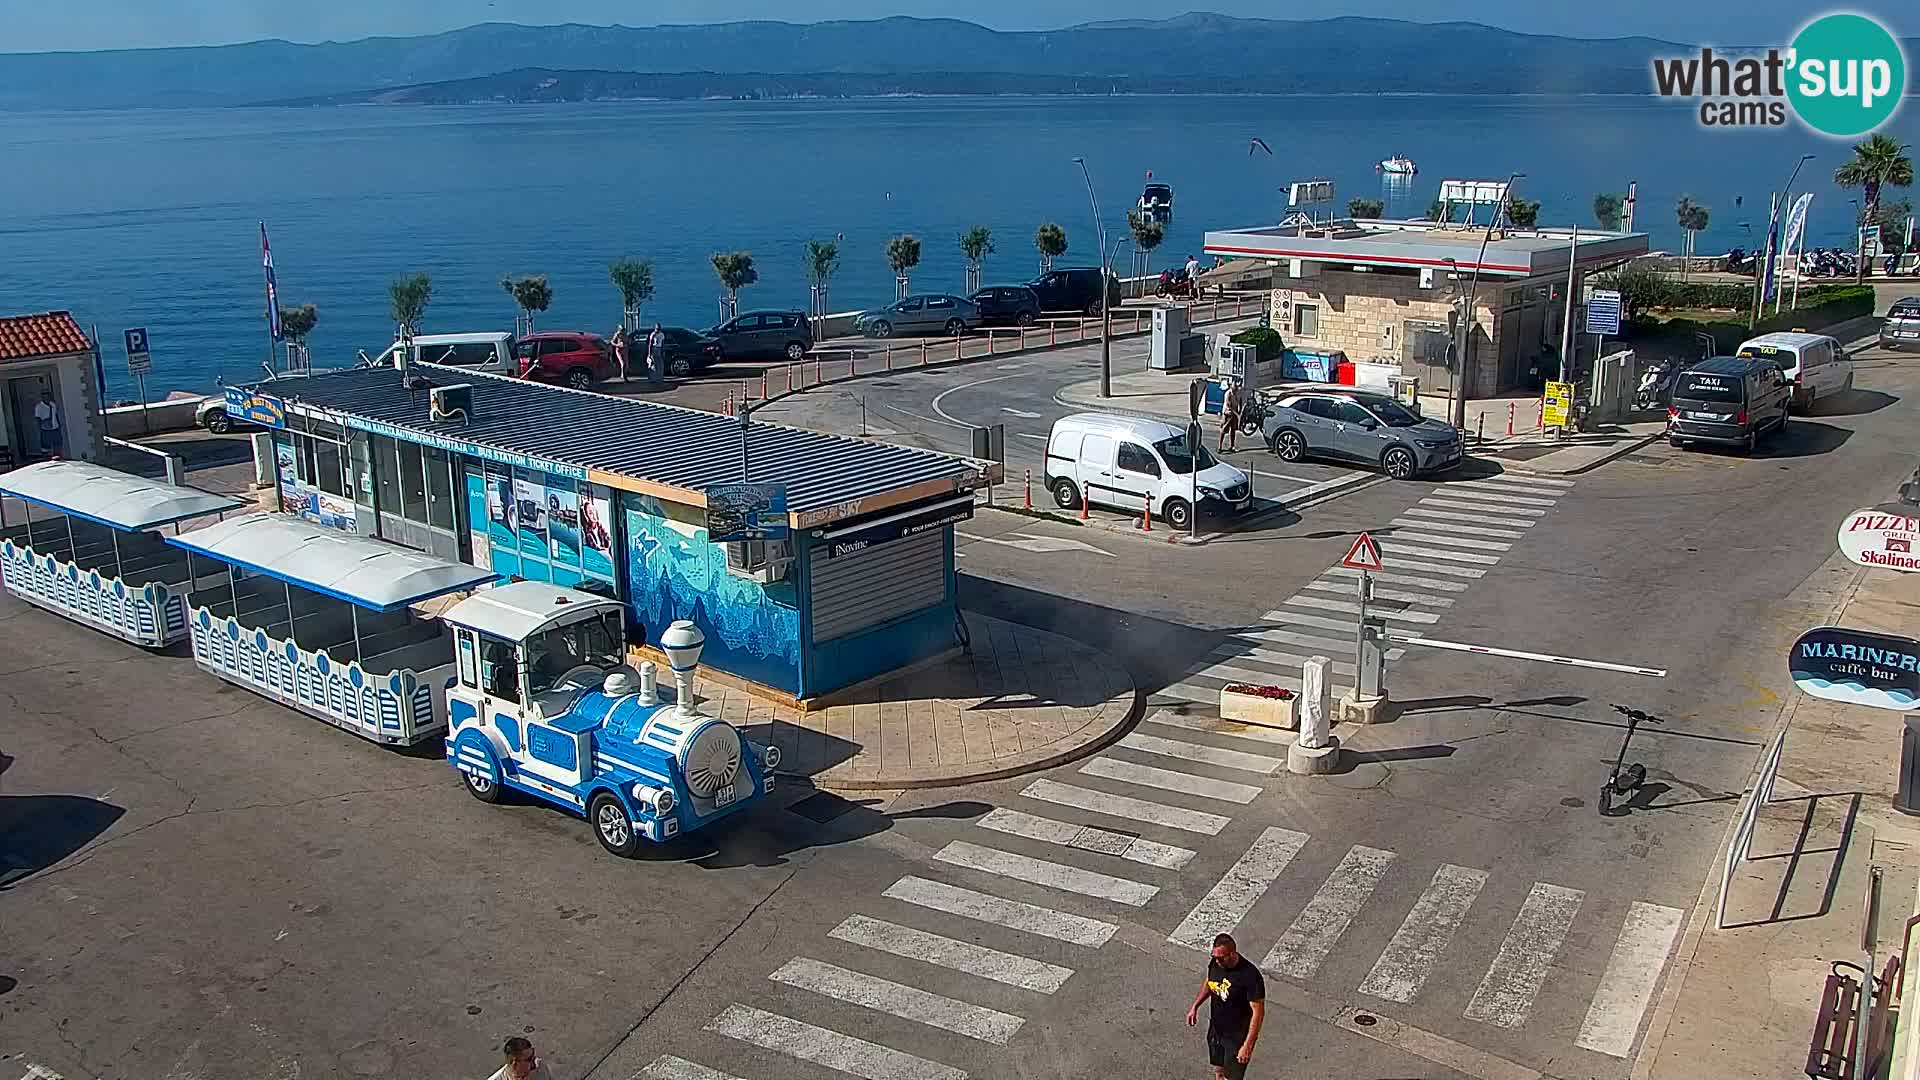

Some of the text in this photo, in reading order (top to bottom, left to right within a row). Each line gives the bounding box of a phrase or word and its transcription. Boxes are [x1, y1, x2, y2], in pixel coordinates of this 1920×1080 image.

[130, 332, 141, 350] P
[1760, 347, 1777, 355] TAXI
[1699, 377, 1720, 386] TAXI
[396, 429, 436, 446] AUTOBUSNA
[437, 439, 468, 452] POSTAJA
[478, 445, 493, 459] BUS
[494, 449, 526, 465] STATION
[529, 457, 554, 471] TICKET
[556, 463, 582, 478] OFFICE
[1882, 530, 1918, 541] GRILL
[1830, 662, 1899, 680] caffe bar
